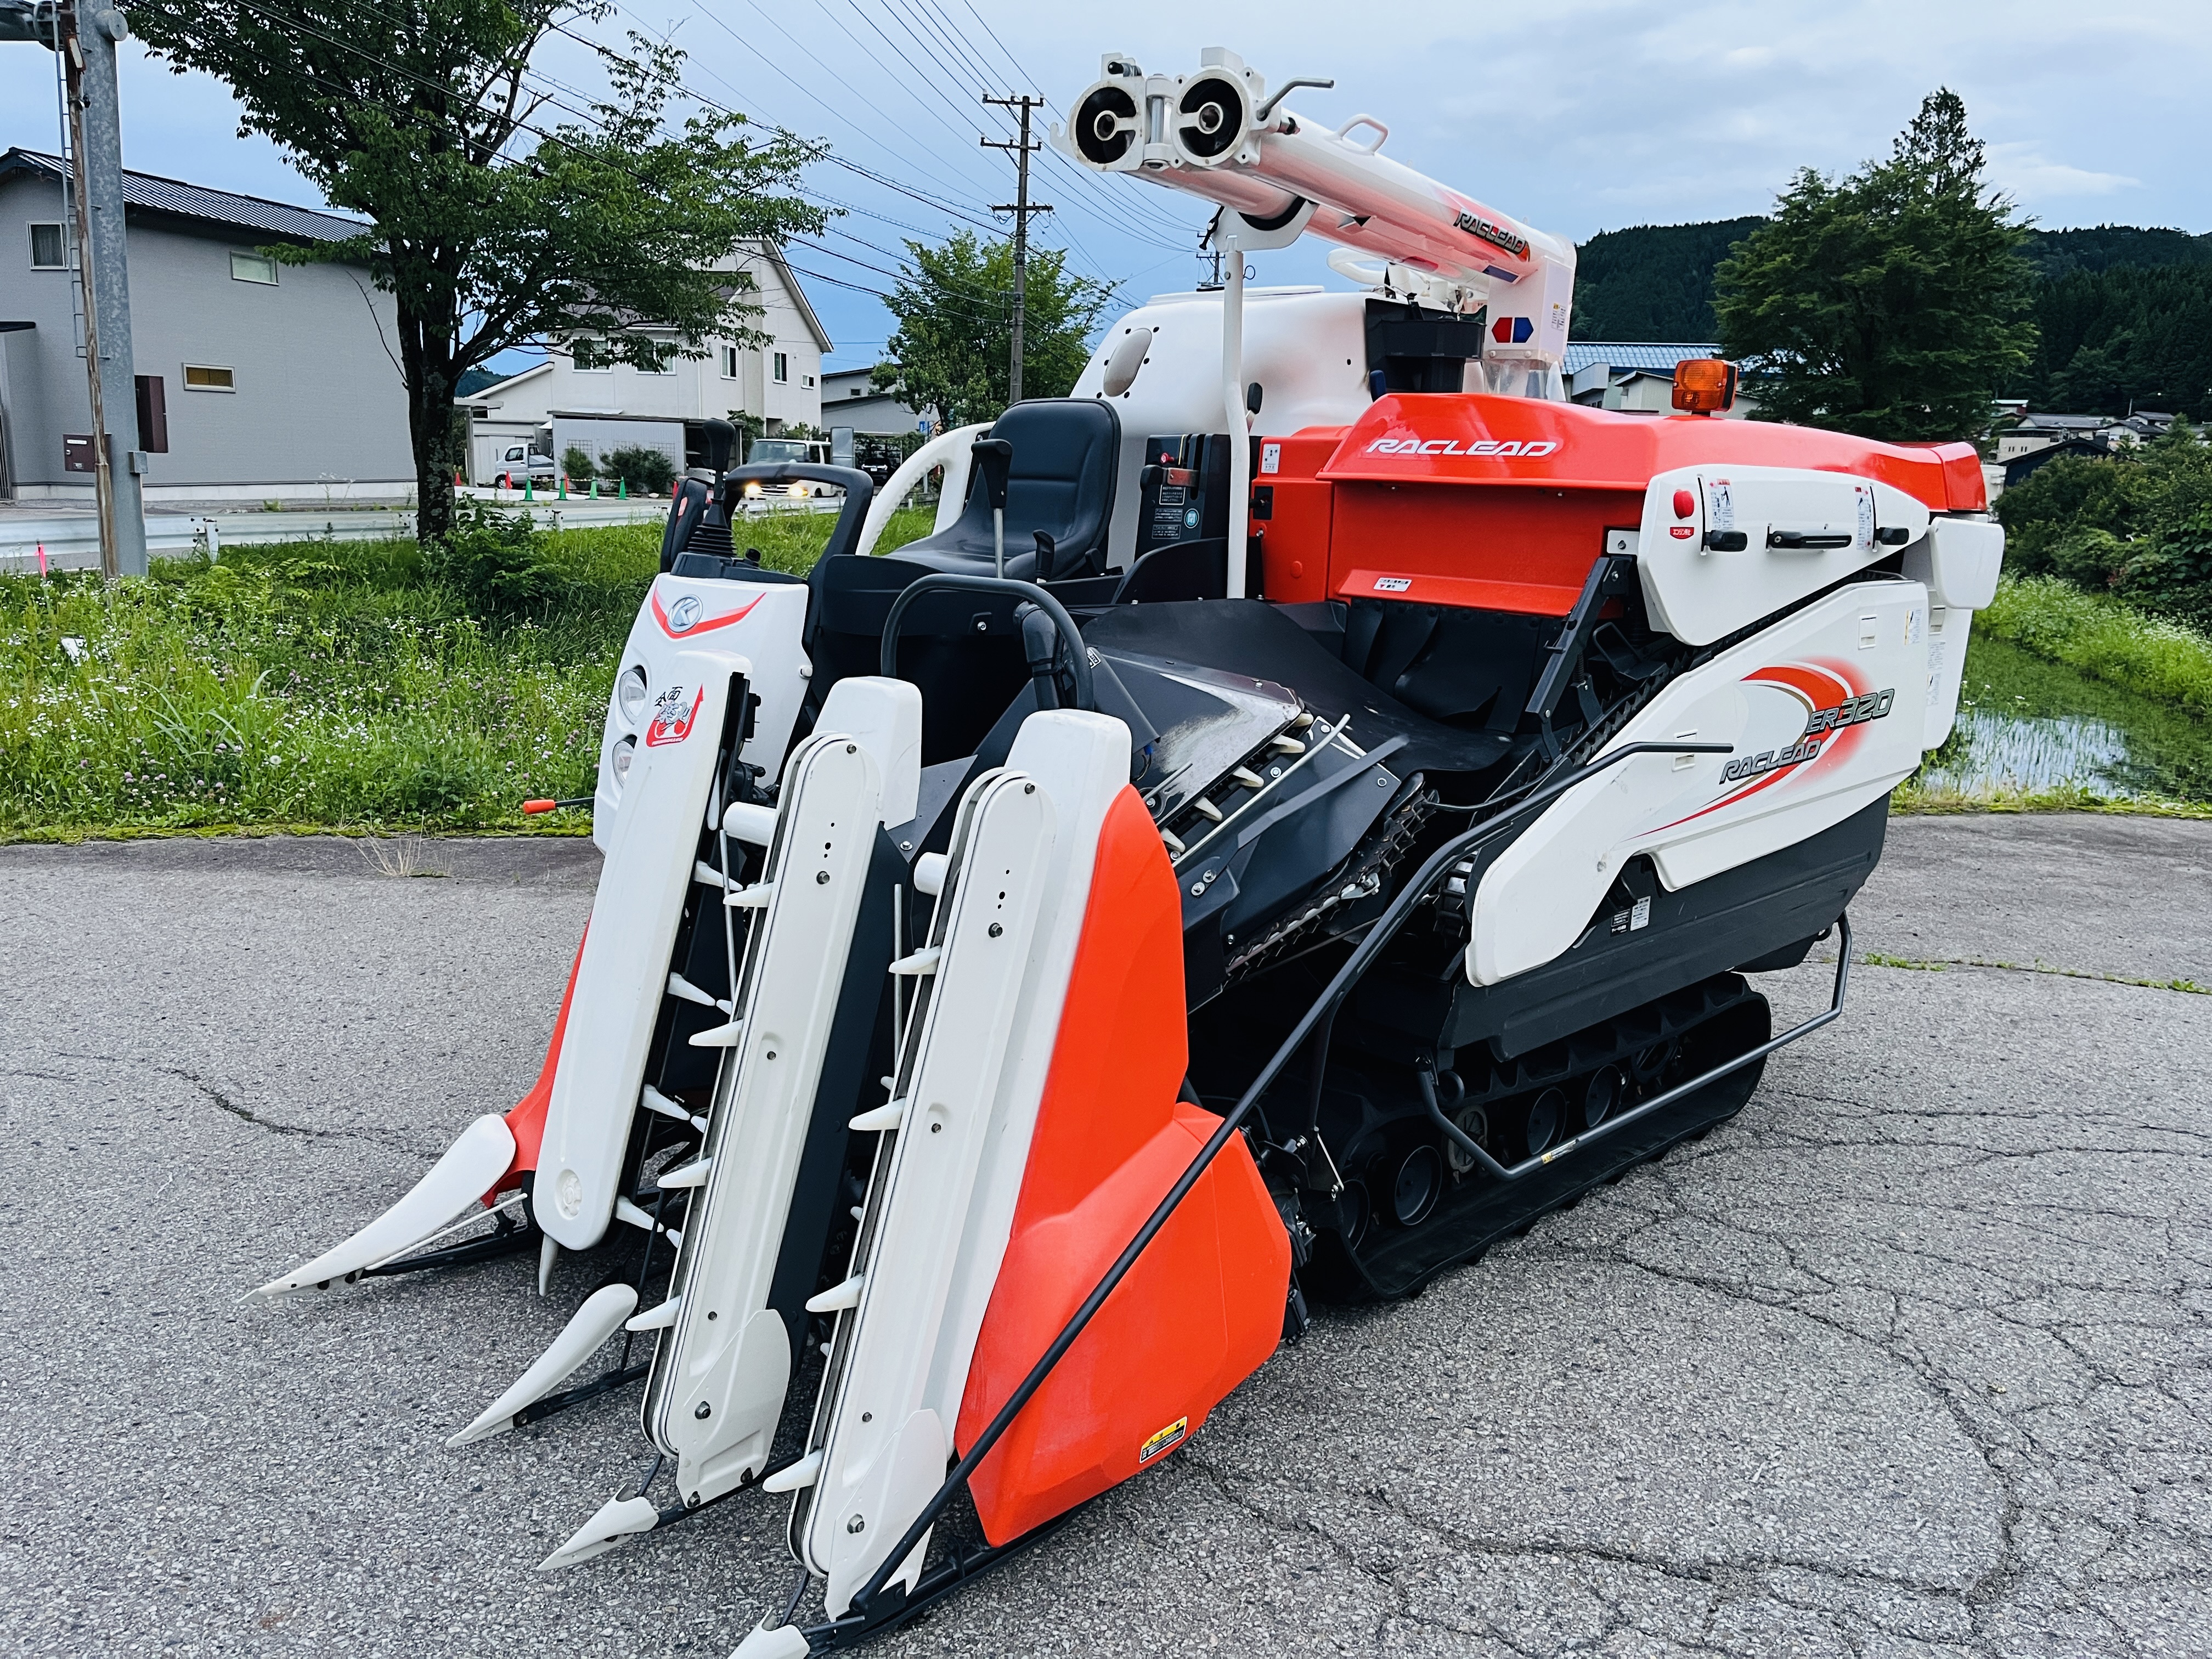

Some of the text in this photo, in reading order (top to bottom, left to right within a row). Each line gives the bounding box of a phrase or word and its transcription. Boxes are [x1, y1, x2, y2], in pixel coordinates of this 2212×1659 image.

[1453, 208, 1527, 255] RACLEAD
[1366, 439, 1557, 457] RACLEAD
[1805, 689, 1895, 736] ER320
[1719, 740, 1822, 785] RACLEAD
